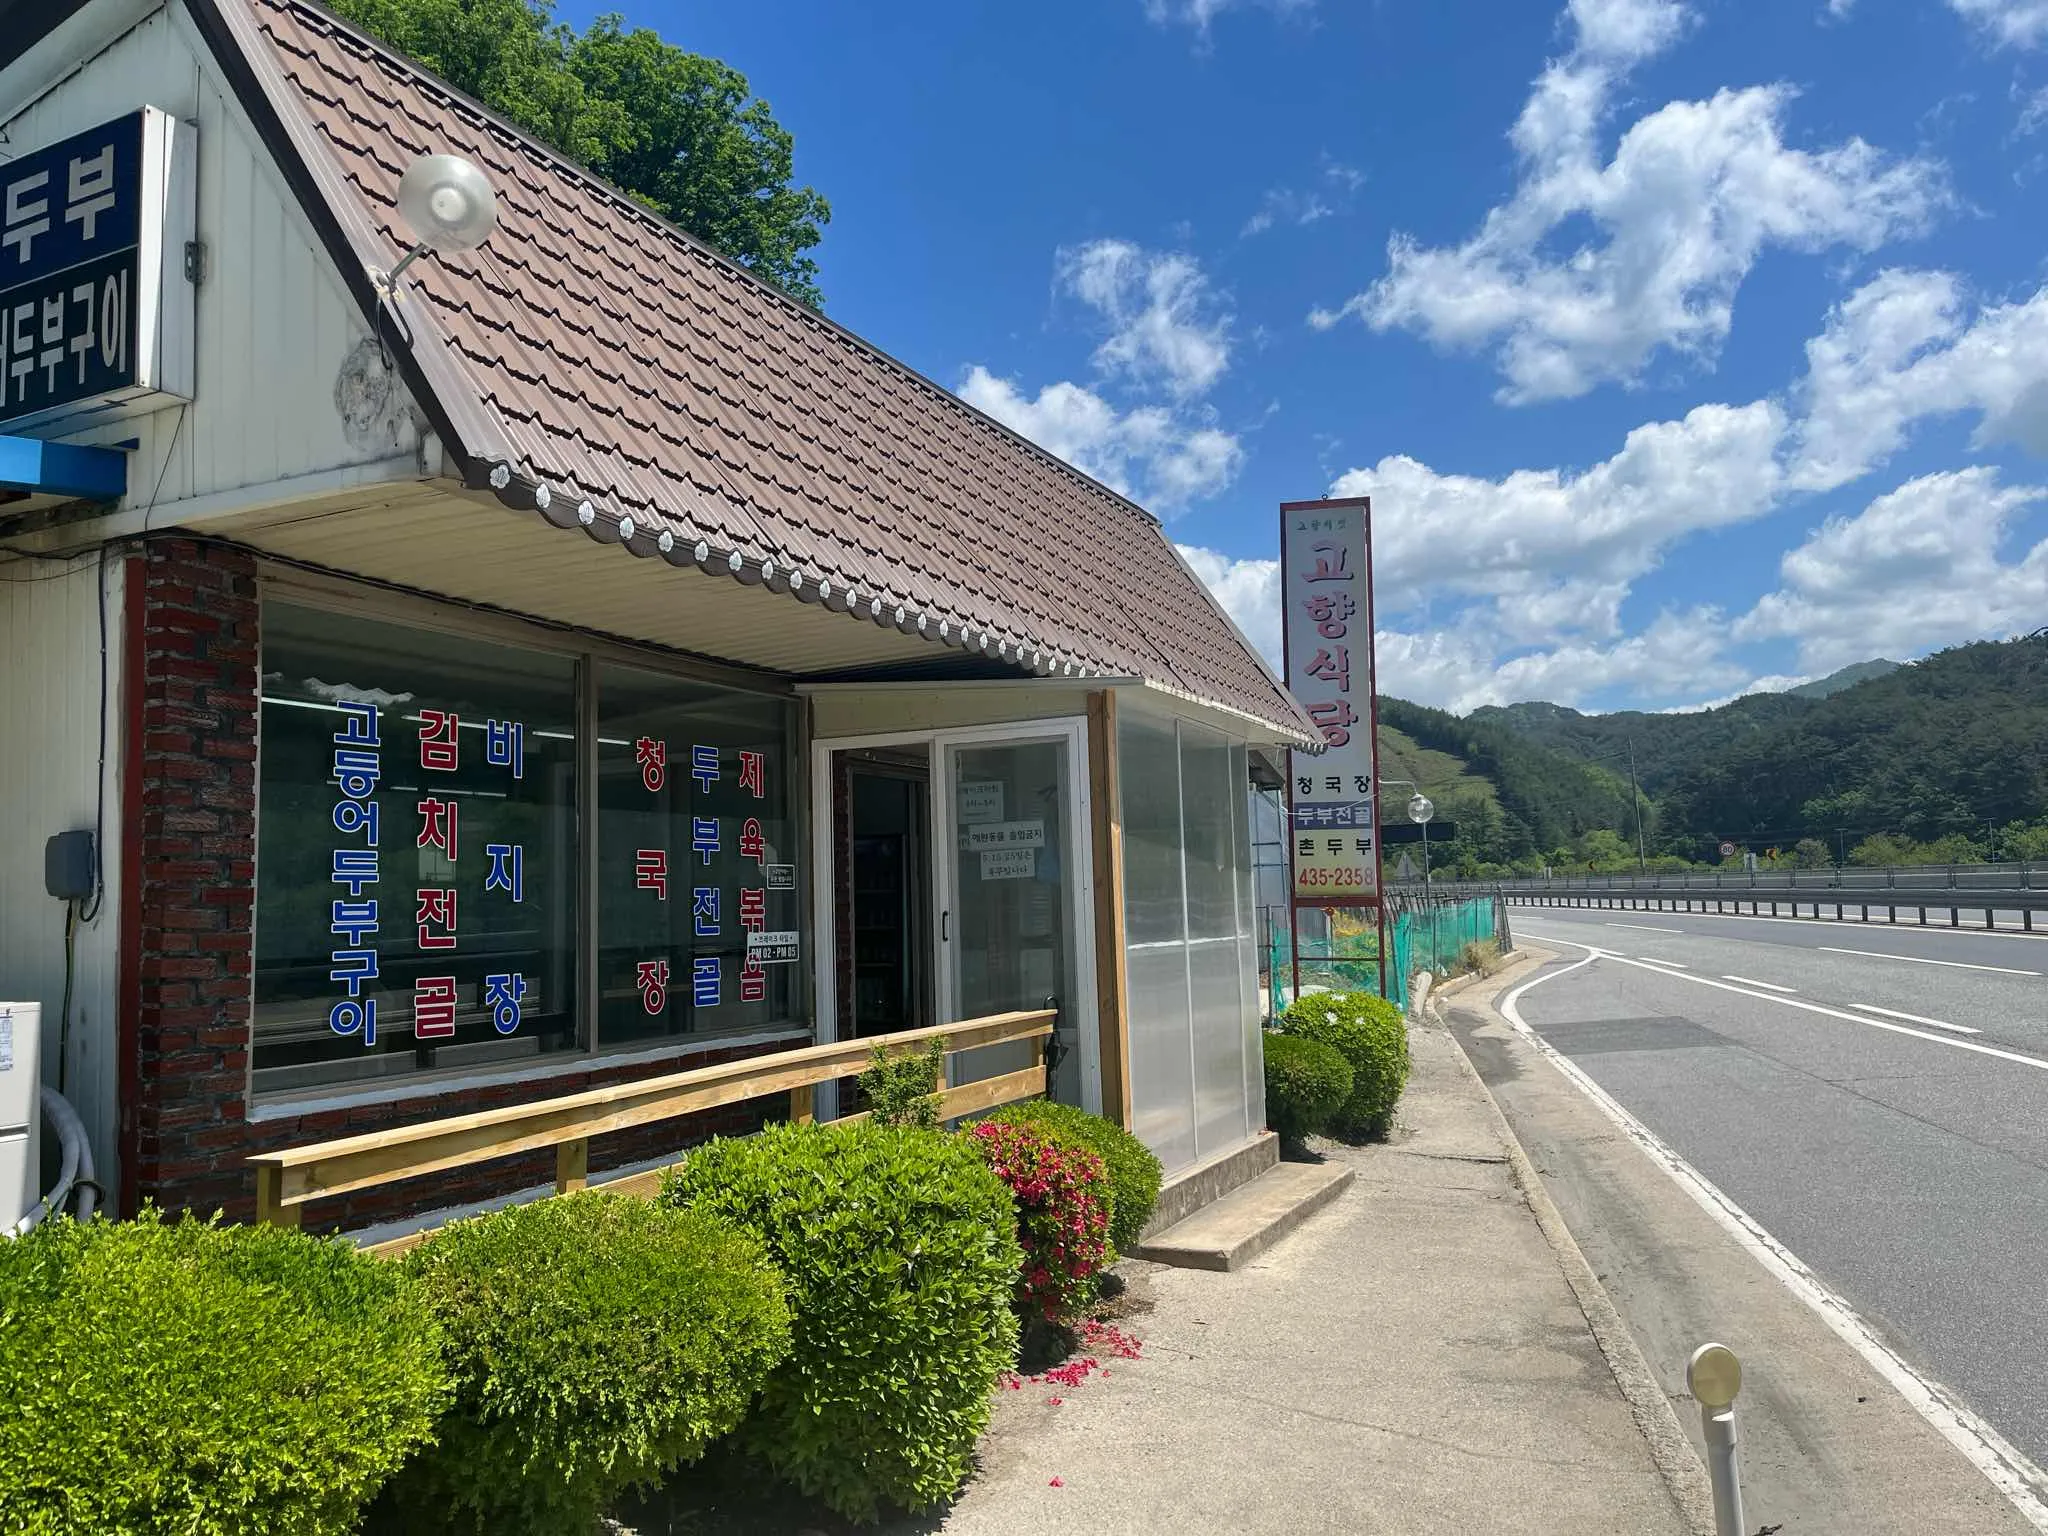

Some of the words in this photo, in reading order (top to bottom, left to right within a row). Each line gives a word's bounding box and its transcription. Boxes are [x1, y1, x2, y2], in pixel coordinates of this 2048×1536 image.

[2, 144, 115, 264] 두부
[1301, 538, 1359, 749] 고향식당
[330, 699, 381, 1046] 고등어두부구이
[414, 709, 458, 1039] 김치전골
[485, 719, 526, 1035] 비지장
[636, 736, 669, 1016] 청국장
[691, 744, 721, 1008] 두부전골
[739, 750, 766, 1002] 제육볶음
[1297, 775, 1371, 795] 청국장
[1297, 806, 1371, 825] 두부전골
[1299, 838, 1372, 856] 촌두부
[1299, 867, 1374, 887] 435-2358
[763, 947, 771, 958] 02
[777, 946, 786, 958] PM
[787, 946, 796, 957] 05
